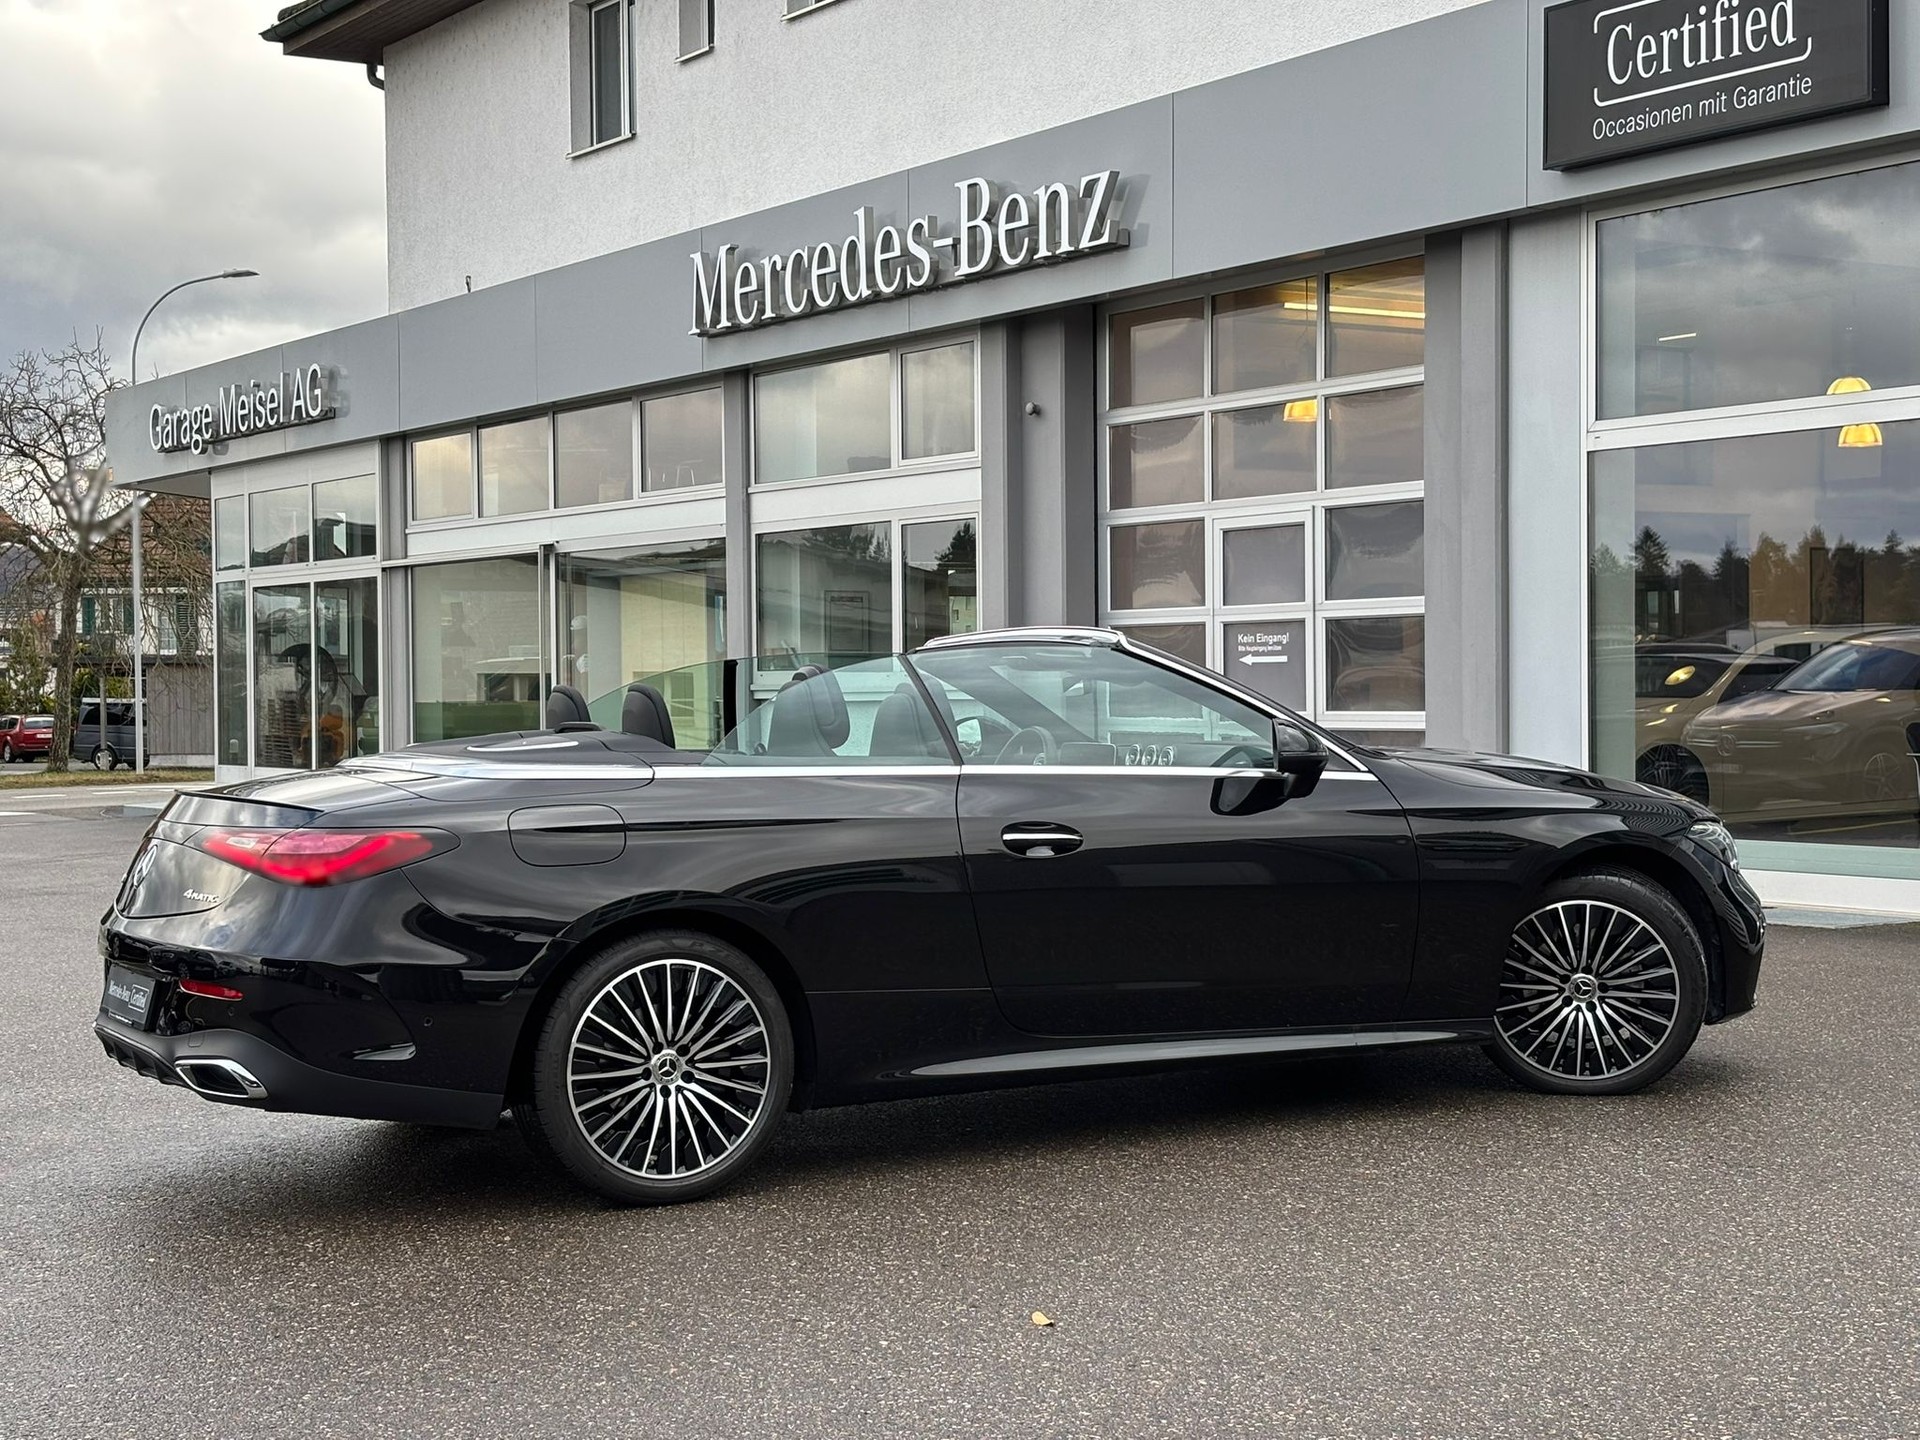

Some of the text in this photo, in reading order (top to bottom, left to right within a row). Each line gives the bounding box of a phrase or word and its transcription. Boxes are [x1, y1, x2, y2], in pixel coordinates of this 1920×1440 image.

[1606, 0, 1797, 85] Certified
[1593, 74, 1812, 141] Occasionen mit Garantie
[688, 170, 1122, 336] Mercedes-Benz
[149, 363, 322, 455] Garage Meisel AG
[1237, 632, 1290, 645] Kein Eingang!
